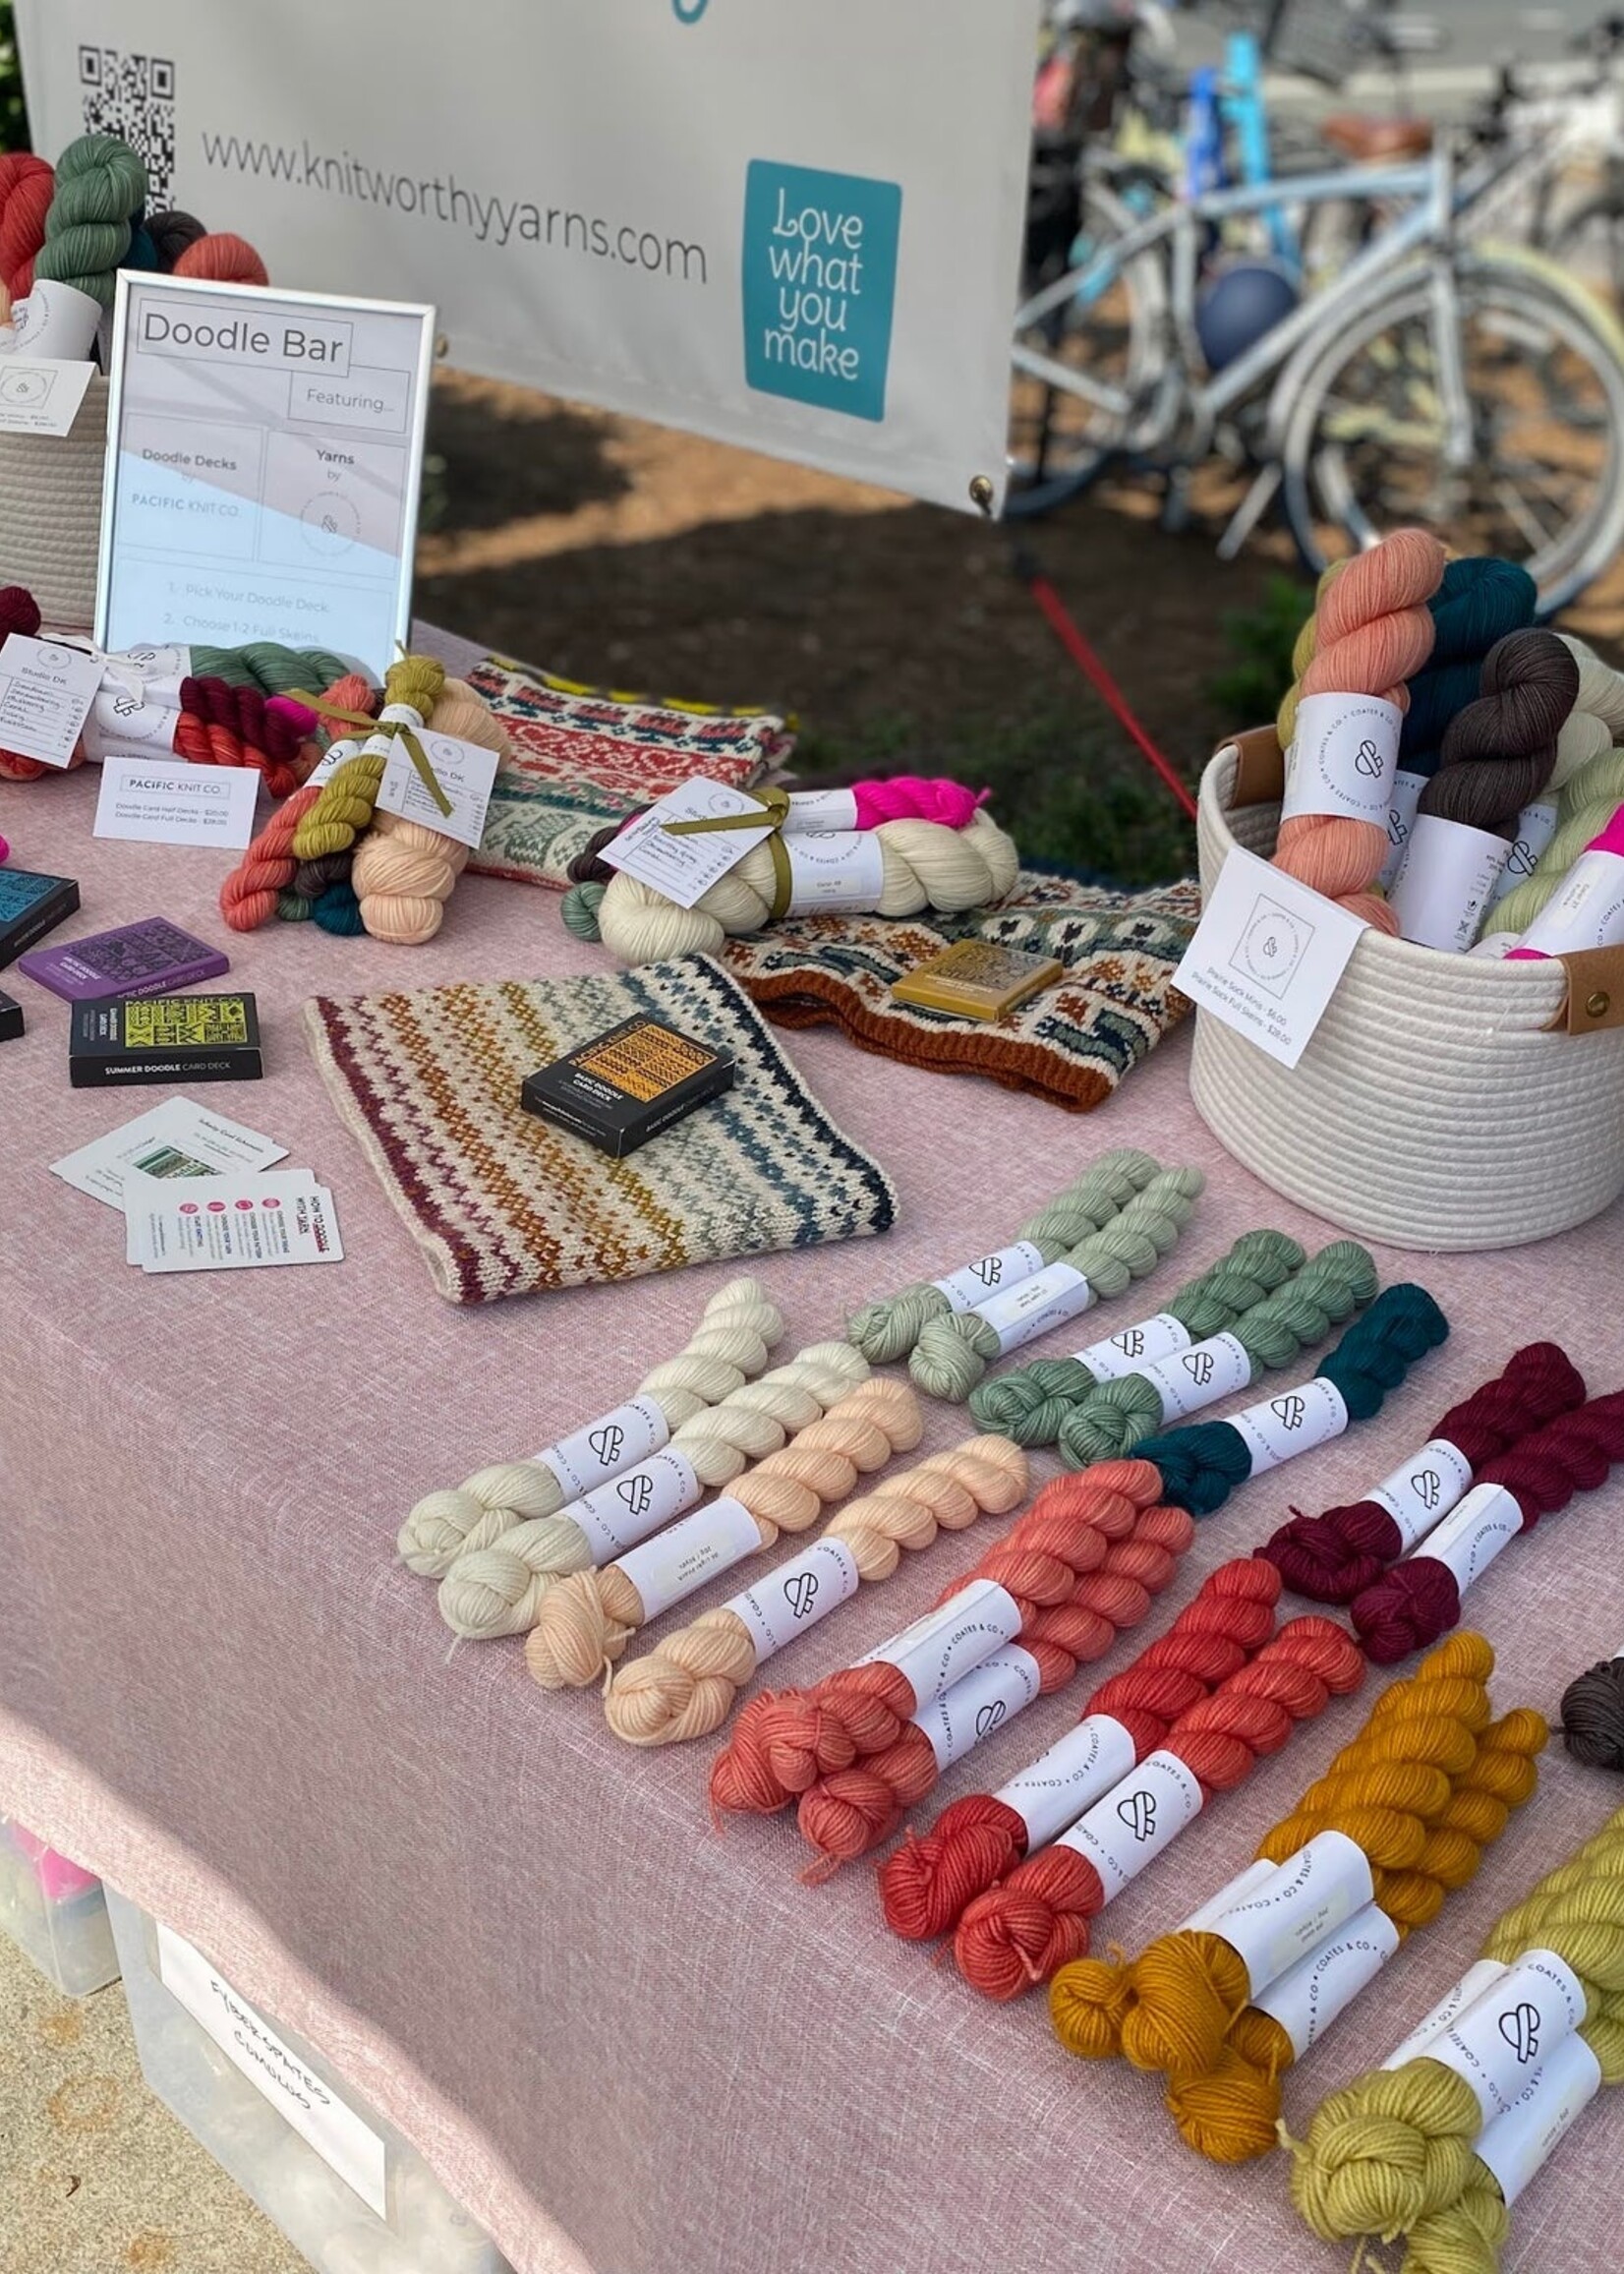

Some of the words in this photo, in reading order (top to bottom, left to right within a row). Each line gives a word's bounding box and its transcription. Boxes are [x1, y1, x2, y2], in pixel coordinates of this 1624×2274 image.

[203, 131, 707, 285] www.knitworthyyarns.com
[773, 188, 863, 249] Love
[769, 242, 863, 295] what
[780, 288, 846, 331] you
[144, 313, 270, 355] Doodle
[282, 328, 344, 363] Bar
[764, 328, 858, 380] make
[142, 448, 191, 466] Doodle
[195, 455, 237, 471] Decks
[316, 448, 355, 465] Yarns
[327, 468, 342, 483] by
[132, 494, 185, 511] PACIFIC
[188, 498, 217, 513] KNIT
[186, 584, 213, 598] Pick
[215, 588, 244, 604] Your
[247, 592, 292, 608] Doodle
[183, 614, 231, 632] Choose
[1351, 708, 1378, 718] COATES
[1319, 736, 1329, 765] COATES
[129, 779, 175, 790] PACIFIC
[177, 784, 202, 792] KNIT
[138, 981, 167, 995] DOODLE
[104, 1066, 144, 1076] SUMMER
[144, 1064, 181, 1074] DOODLE
[182, 1062, 207, 1071] CARD
[207, 1061, 232, 1070] DECK
[595, 1081, 624, 1101] DOODLE
[310, 1195, 320, 1213] HOW
[952, 1623, 978, 1645] COATES
[987, 1623, 999, 1634] CO
[941, 1653, 951, 1667] CO
[1014, 1664, 1032, 1695] COATES
[941, 1709, 954, 1749] COATES
[1089, 1732, 1100, 1765] COATES
[1073, 1770, 1084, 1781] CO
[1145, 1761, 1182, 1780] COATES
[1185, 1793, 1191, 1809] CO
[1108, 1856, 1119, 1870] CO
[1283, 1886, 1298, 1898] CO
[1316, 1945, 1345, 1972] COATES
[1357, 1940, 1370, 1951] CO
[1528, 1963, 1567, 1993] COATES
[1309, 1983, 1319, 2002] CO
[1521, 2086, 1536, 2101] CO
